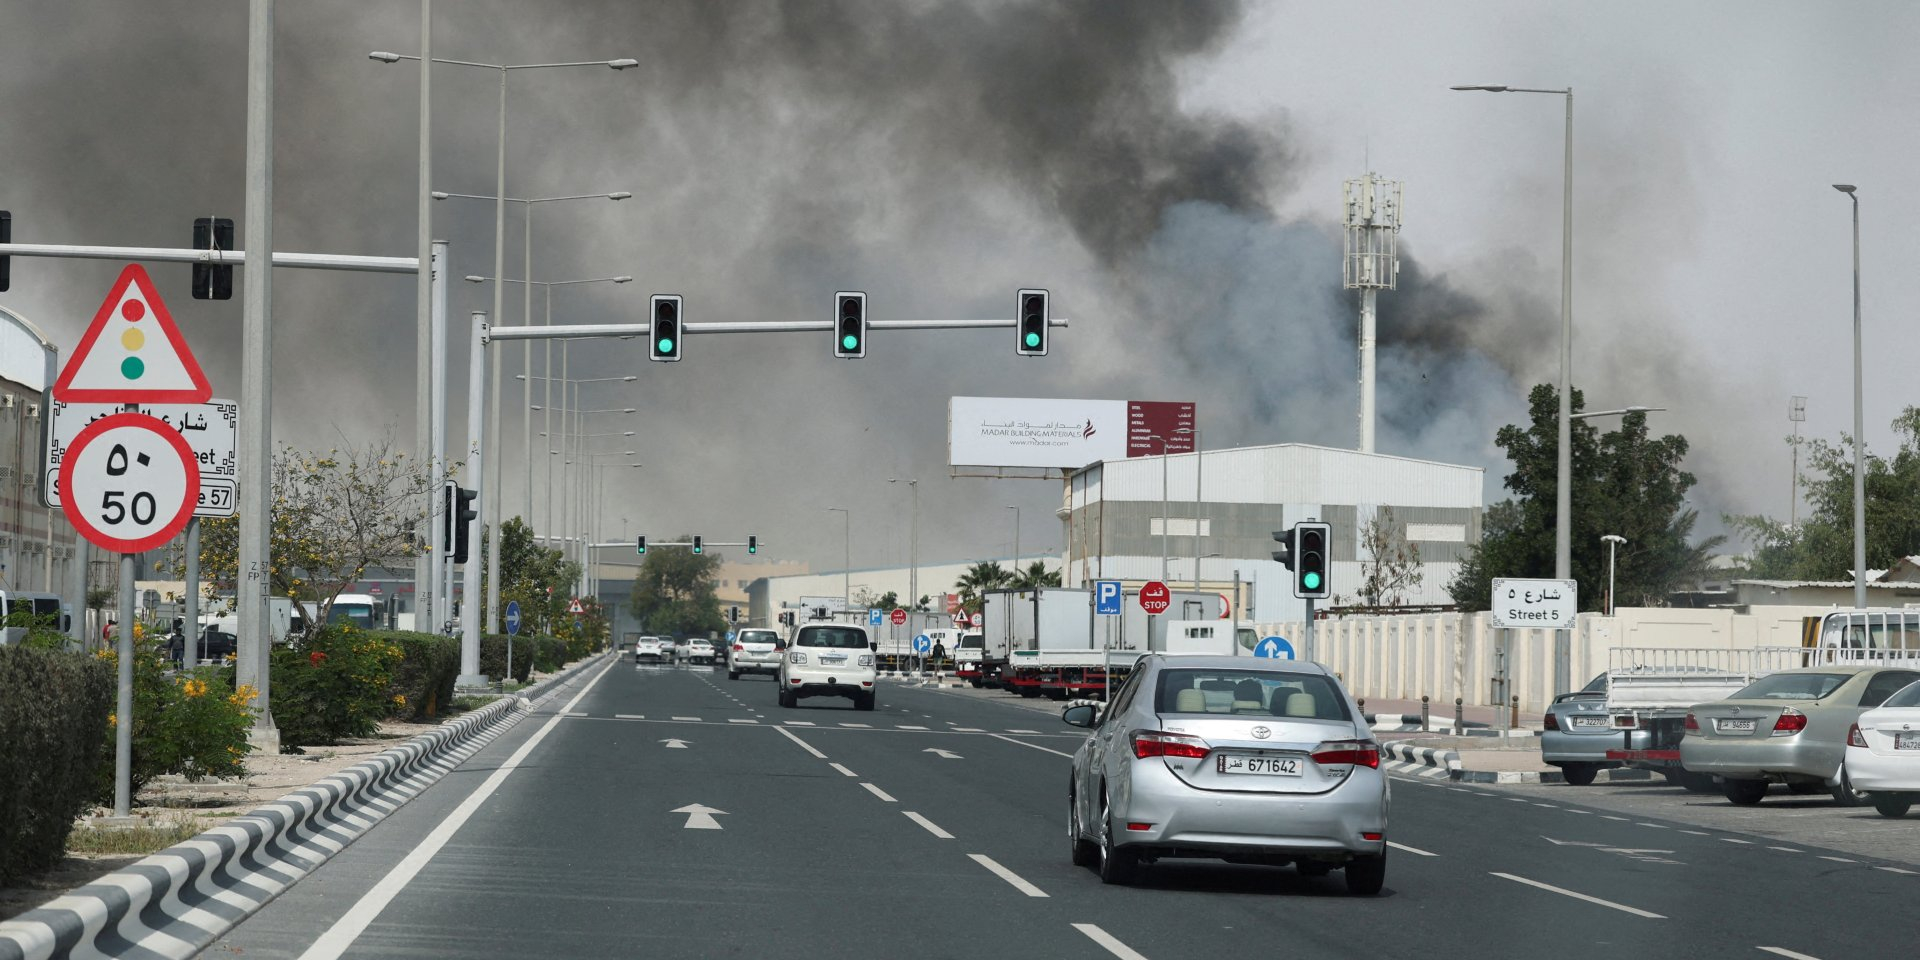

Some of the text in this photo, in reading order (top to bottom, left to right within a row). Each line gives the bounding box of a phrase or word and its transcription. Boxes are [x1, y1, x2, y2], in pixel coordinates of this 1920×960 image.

[981, 428, 1082, 438] MADAR BUILDING MATERIALS
[106, 443, 151, 477] ٥٠
[210, 489, 230, 506] 57
[101, 491, 157, 526] 50
[251, 561, 269, 571] Z 57
[248, 572, 267, 582] FP 7
[1101, 583, 1117, 604] P
[1146, 587, 1164, 597] قف
[1508, 588, 1561, 604] شارع ٥
[1144, 601, 1168, 609] STOP
[871, 610, 880, 621] P
[1508, 608, 1559, 620] Street 5
[1227, 759, 1243, 770] قطر
[1248, 758, 1297, 774] 671642
